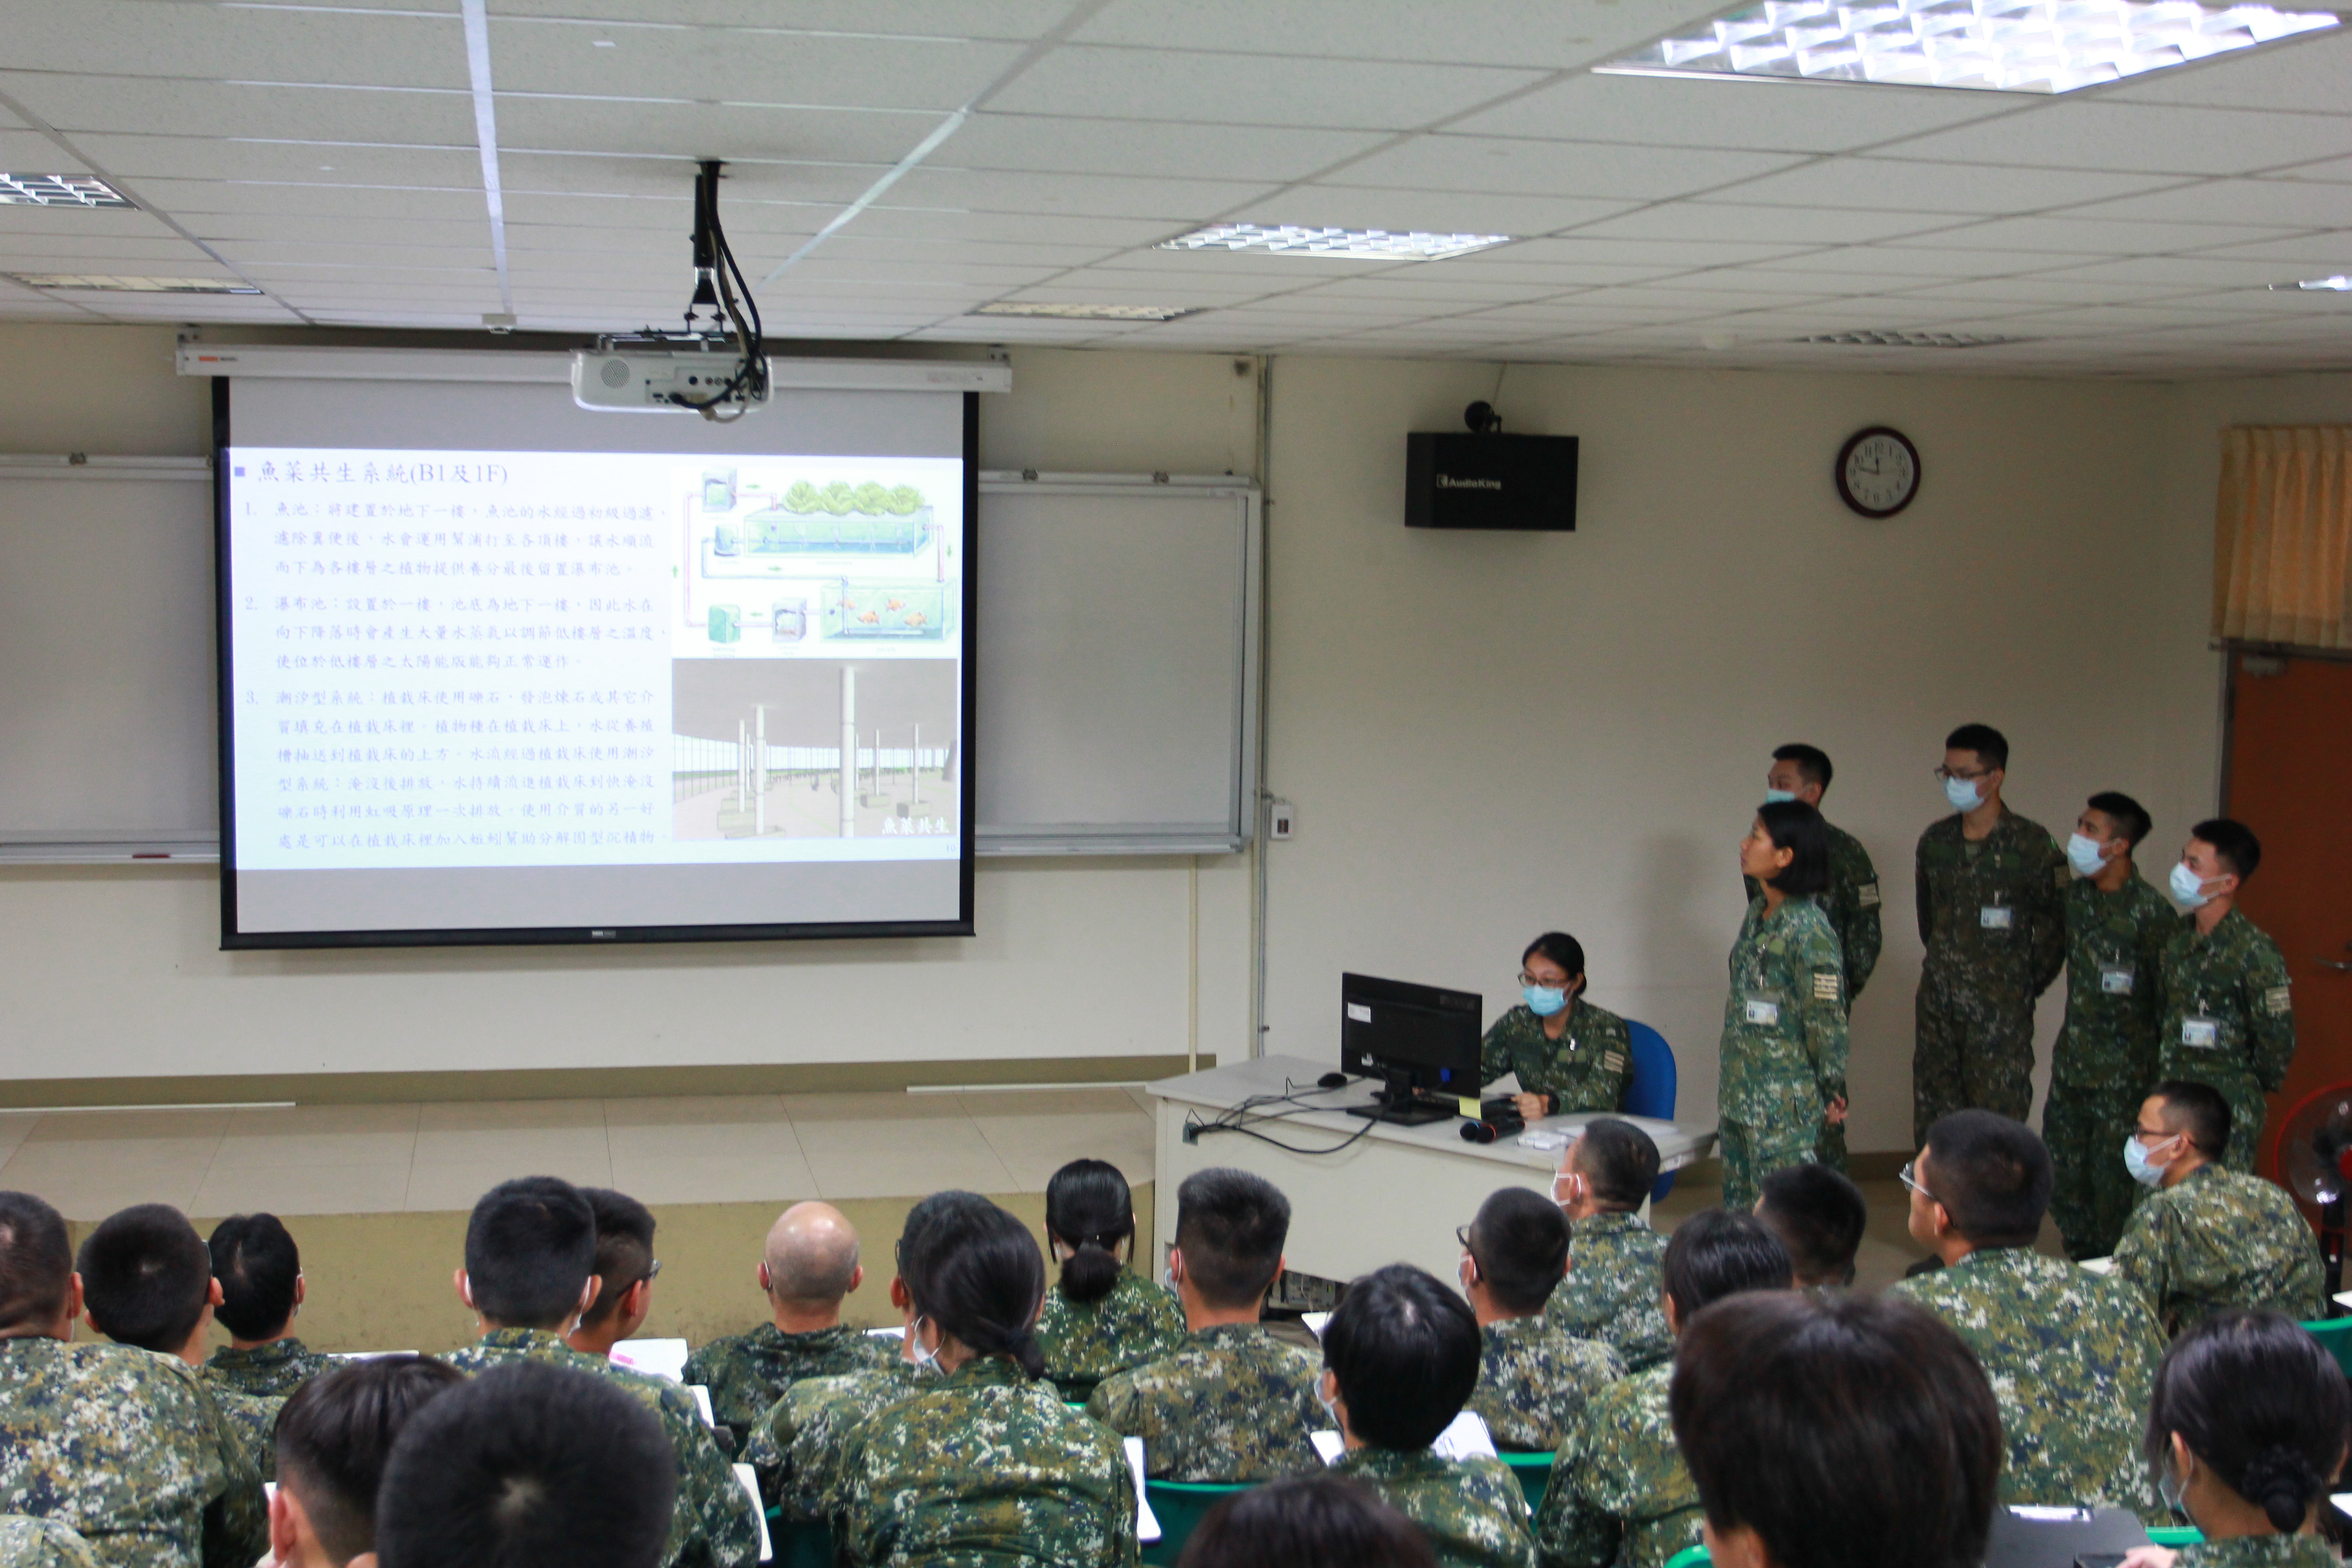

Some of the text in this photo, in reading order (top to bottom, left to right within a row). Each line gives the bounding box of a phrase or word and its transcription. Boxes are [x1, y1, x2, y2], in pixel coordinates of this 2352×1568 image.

[258, 461, 508, 484] 魚菜共生系統(B1及1F)
